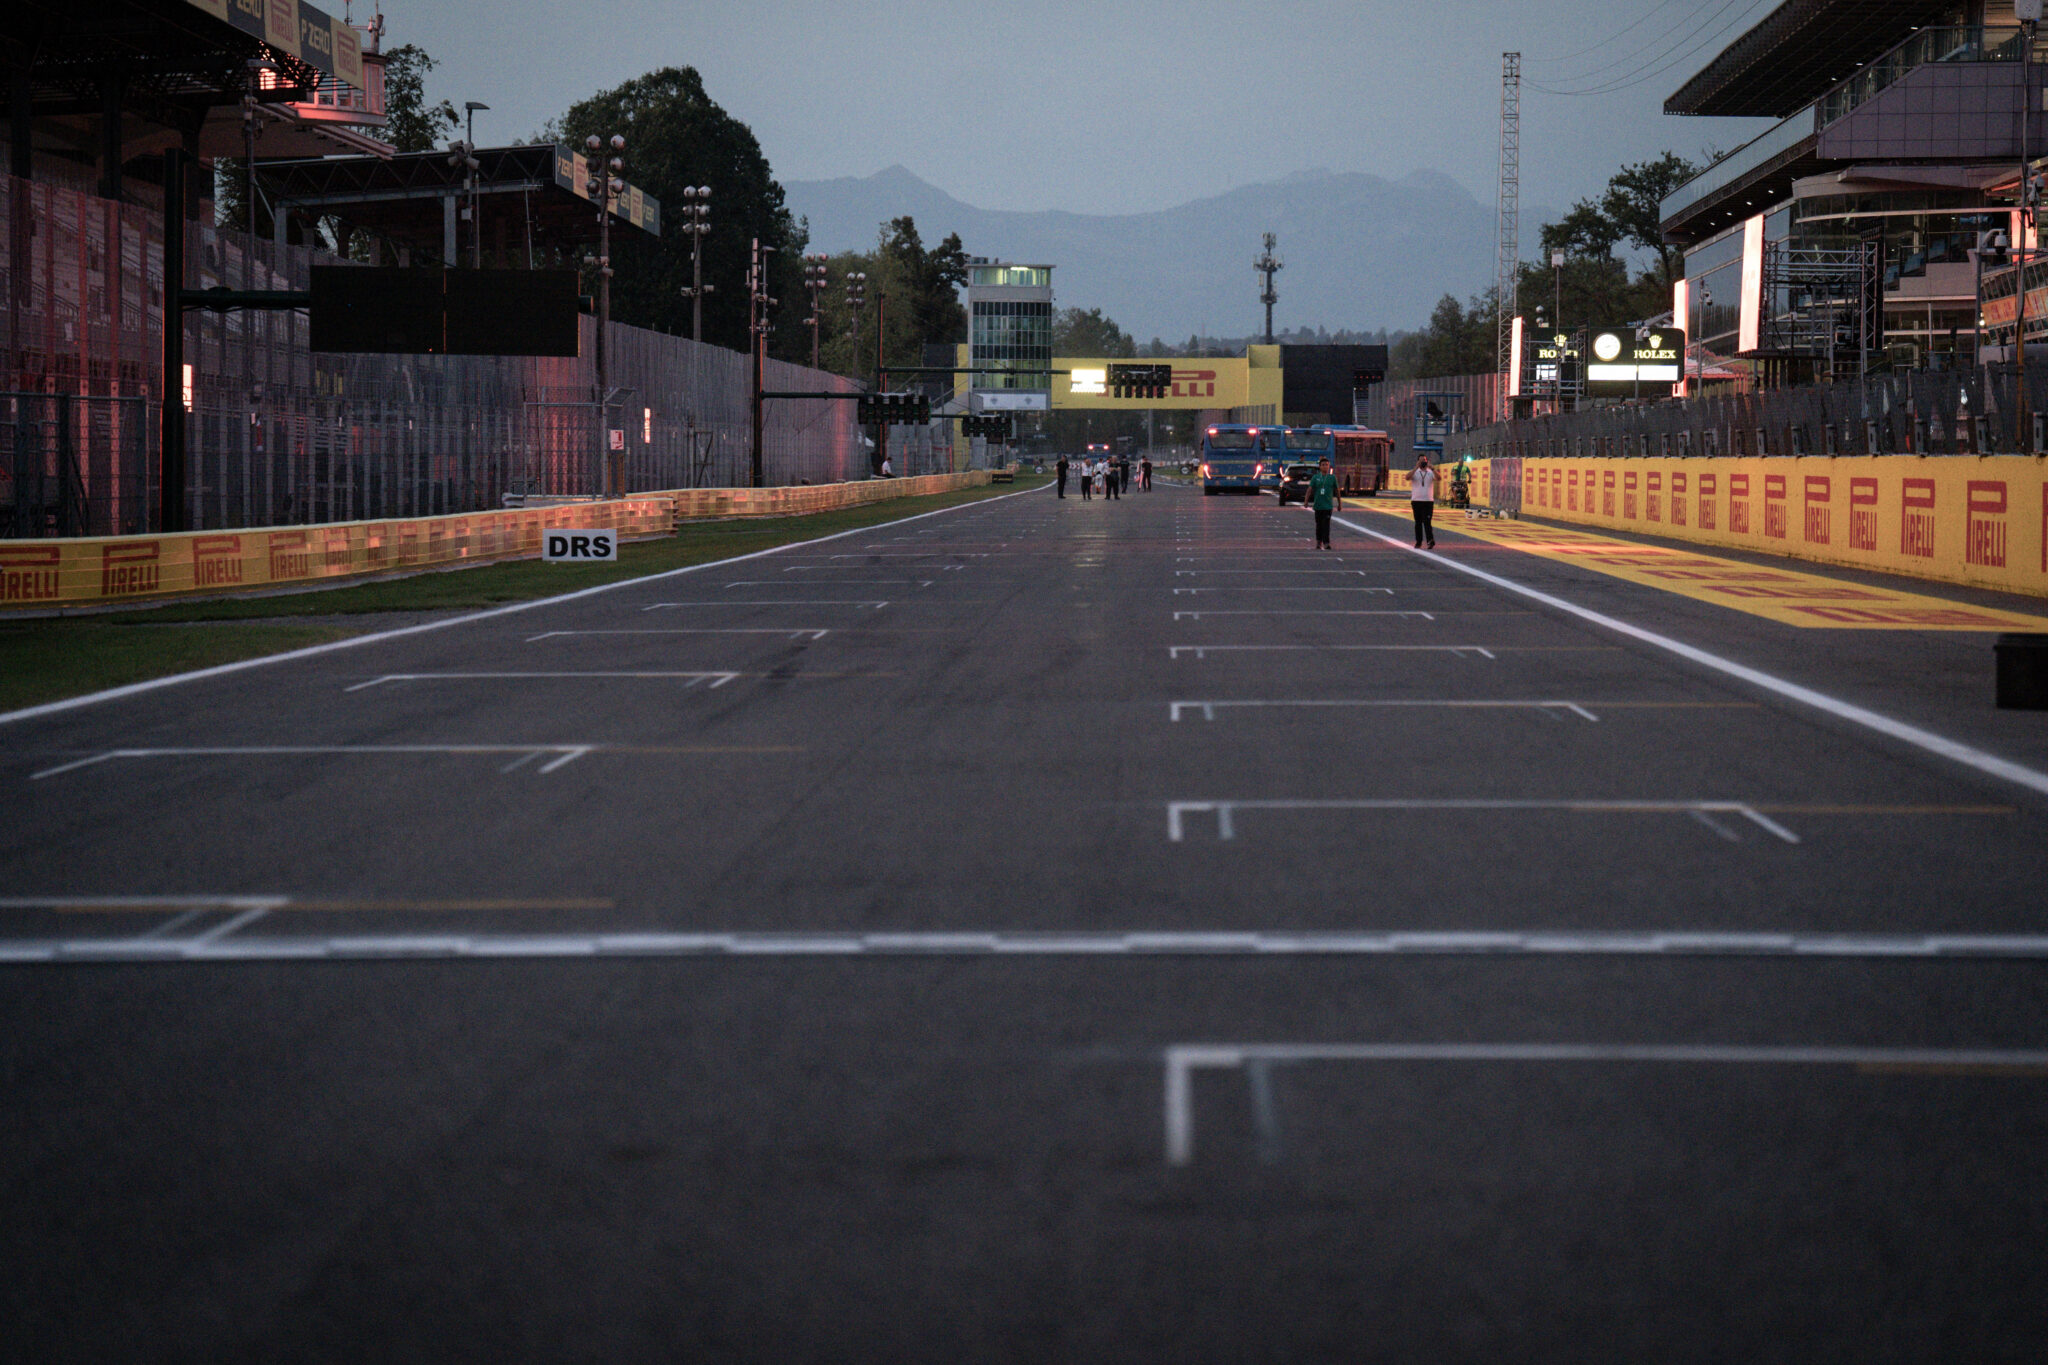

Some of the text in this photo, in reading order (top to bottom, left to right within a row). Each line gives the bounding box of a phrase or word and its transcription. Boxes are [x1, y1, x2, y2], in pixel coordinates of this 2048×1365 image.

[301, 18, 330, 56] P ZERO
[1633, 349, 1677, 360] ROLEX
[1729, 474, 1750, 534] PIRELLI
[1765, 474, 1786, 539] PIRELLI
[1804, 475, 1831, 545] PIRELLI
[1849, 477, 1879, 552] PIRELLI
[1901, 477, 1936, 559] PIRELLI
[1965, 480, 2008, 569] PIRELLI
[101, 541, 160, 596] PIRELLI
[192, 535, 243, 586] PIRELLI
[268, 531, 309, 581] PIRELLI
[549, 536, 611, 558] DRS
